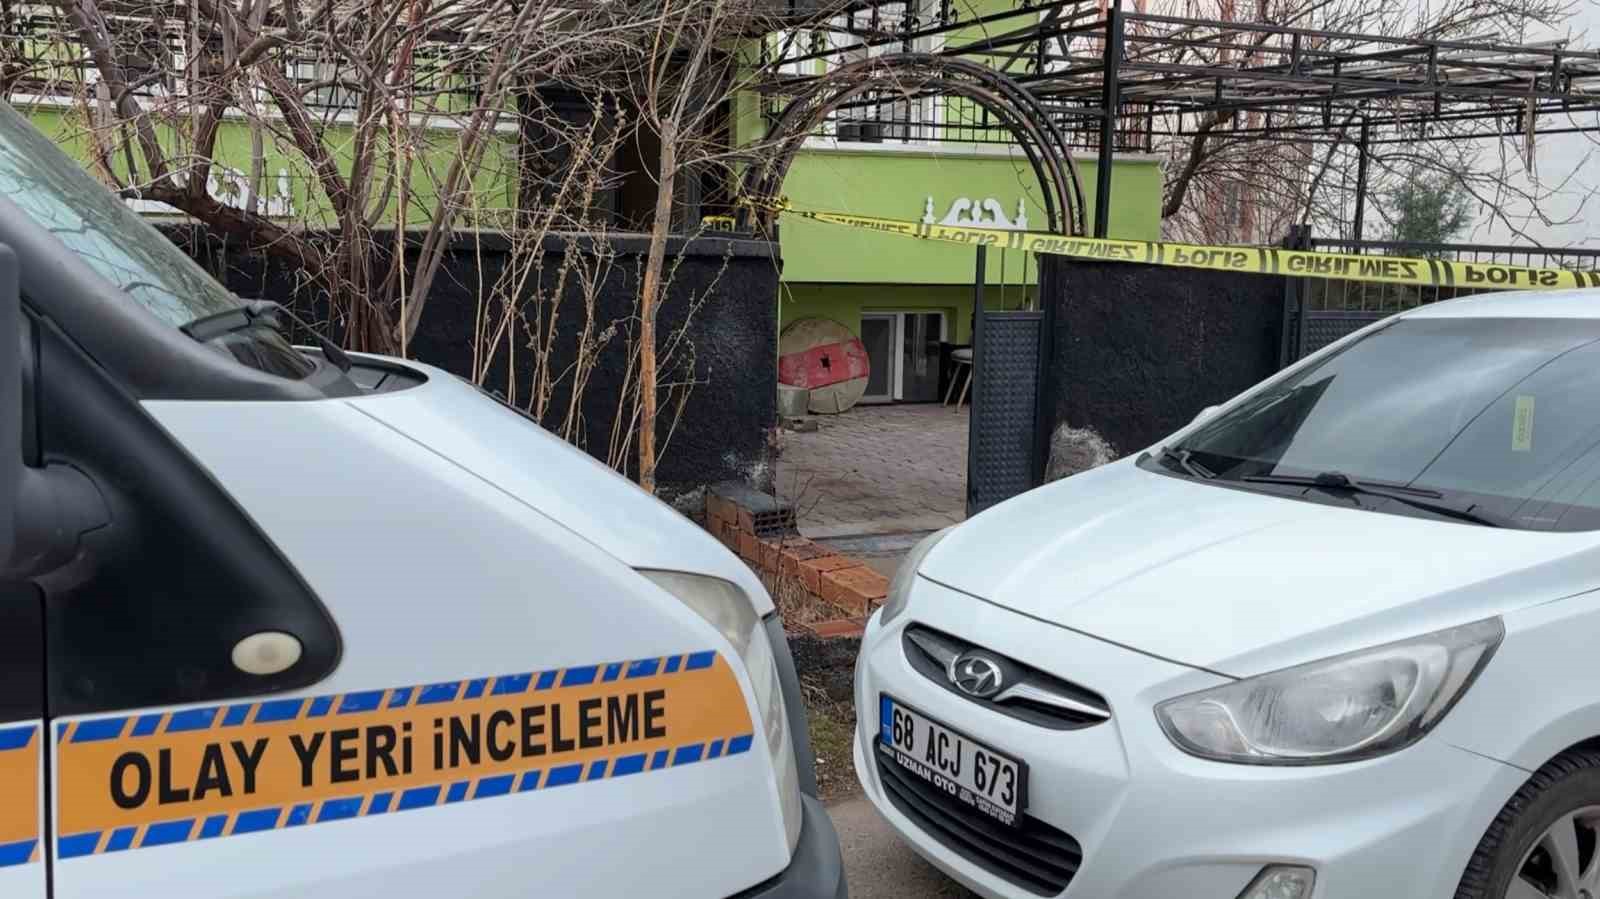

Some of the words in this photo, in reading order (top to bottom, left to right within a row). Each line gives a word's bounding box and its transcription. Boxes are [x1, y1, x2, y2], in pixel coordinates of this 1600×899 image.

[110, 738, 269, 810] OLAY
[893, 707, 914, 752] 68
[926, 726, 962, 778] ACJ
[974, 750, 1015, 806] 673
[896, 751, 932, 782] UZMAN
[933, 773, 957, 796] OTO
